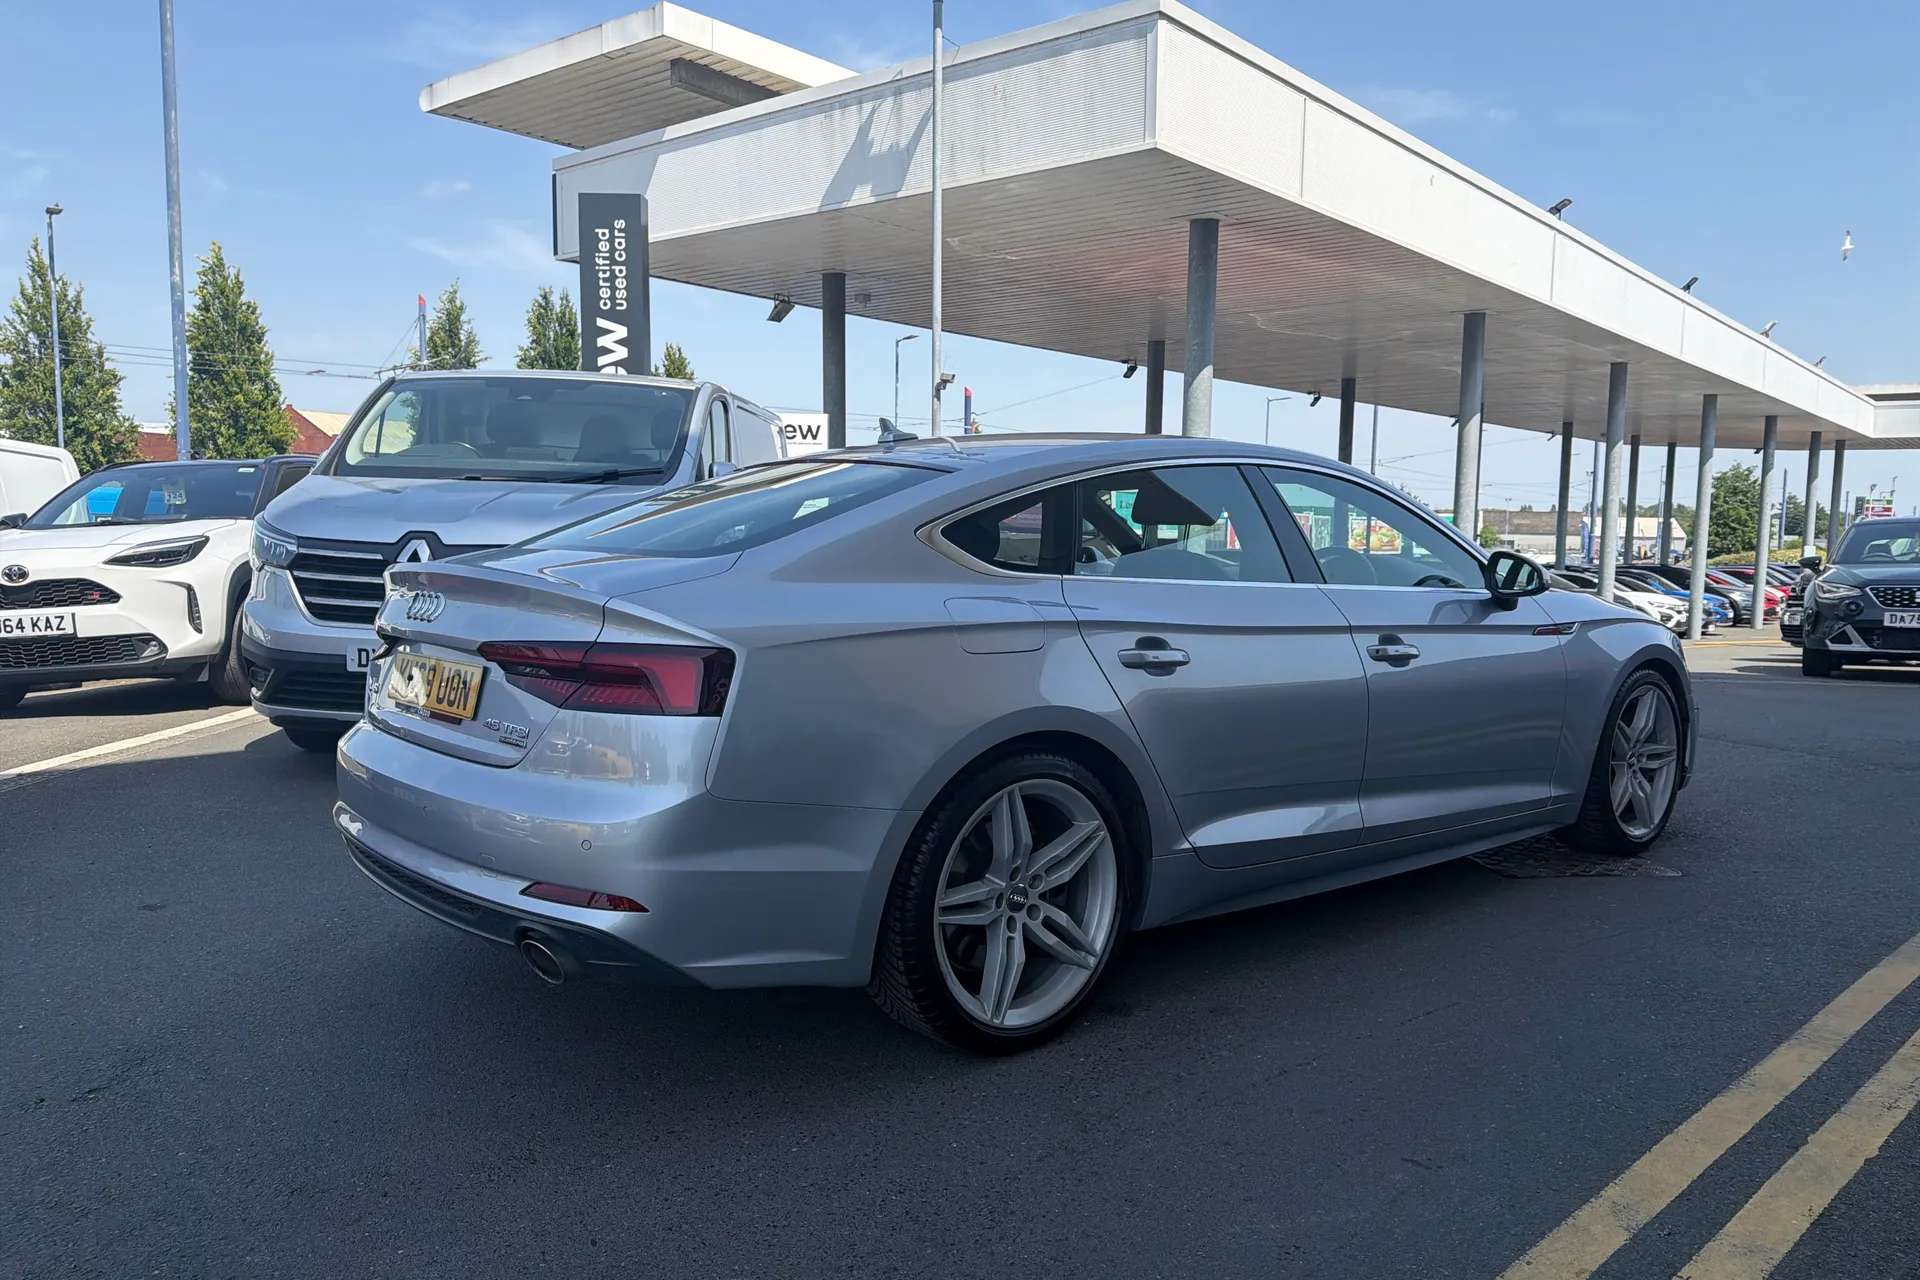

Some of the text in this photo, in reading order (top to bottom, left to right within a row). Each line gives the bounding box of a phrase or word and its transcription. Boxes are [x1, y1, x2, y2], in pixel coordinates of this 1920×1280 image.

[594, 228, 611, 310] certified
[612, 219, 627, 310] used cars
[0, 615, 66, 634] 64 KAZ
[502, 721, 530, 739] TFSI
